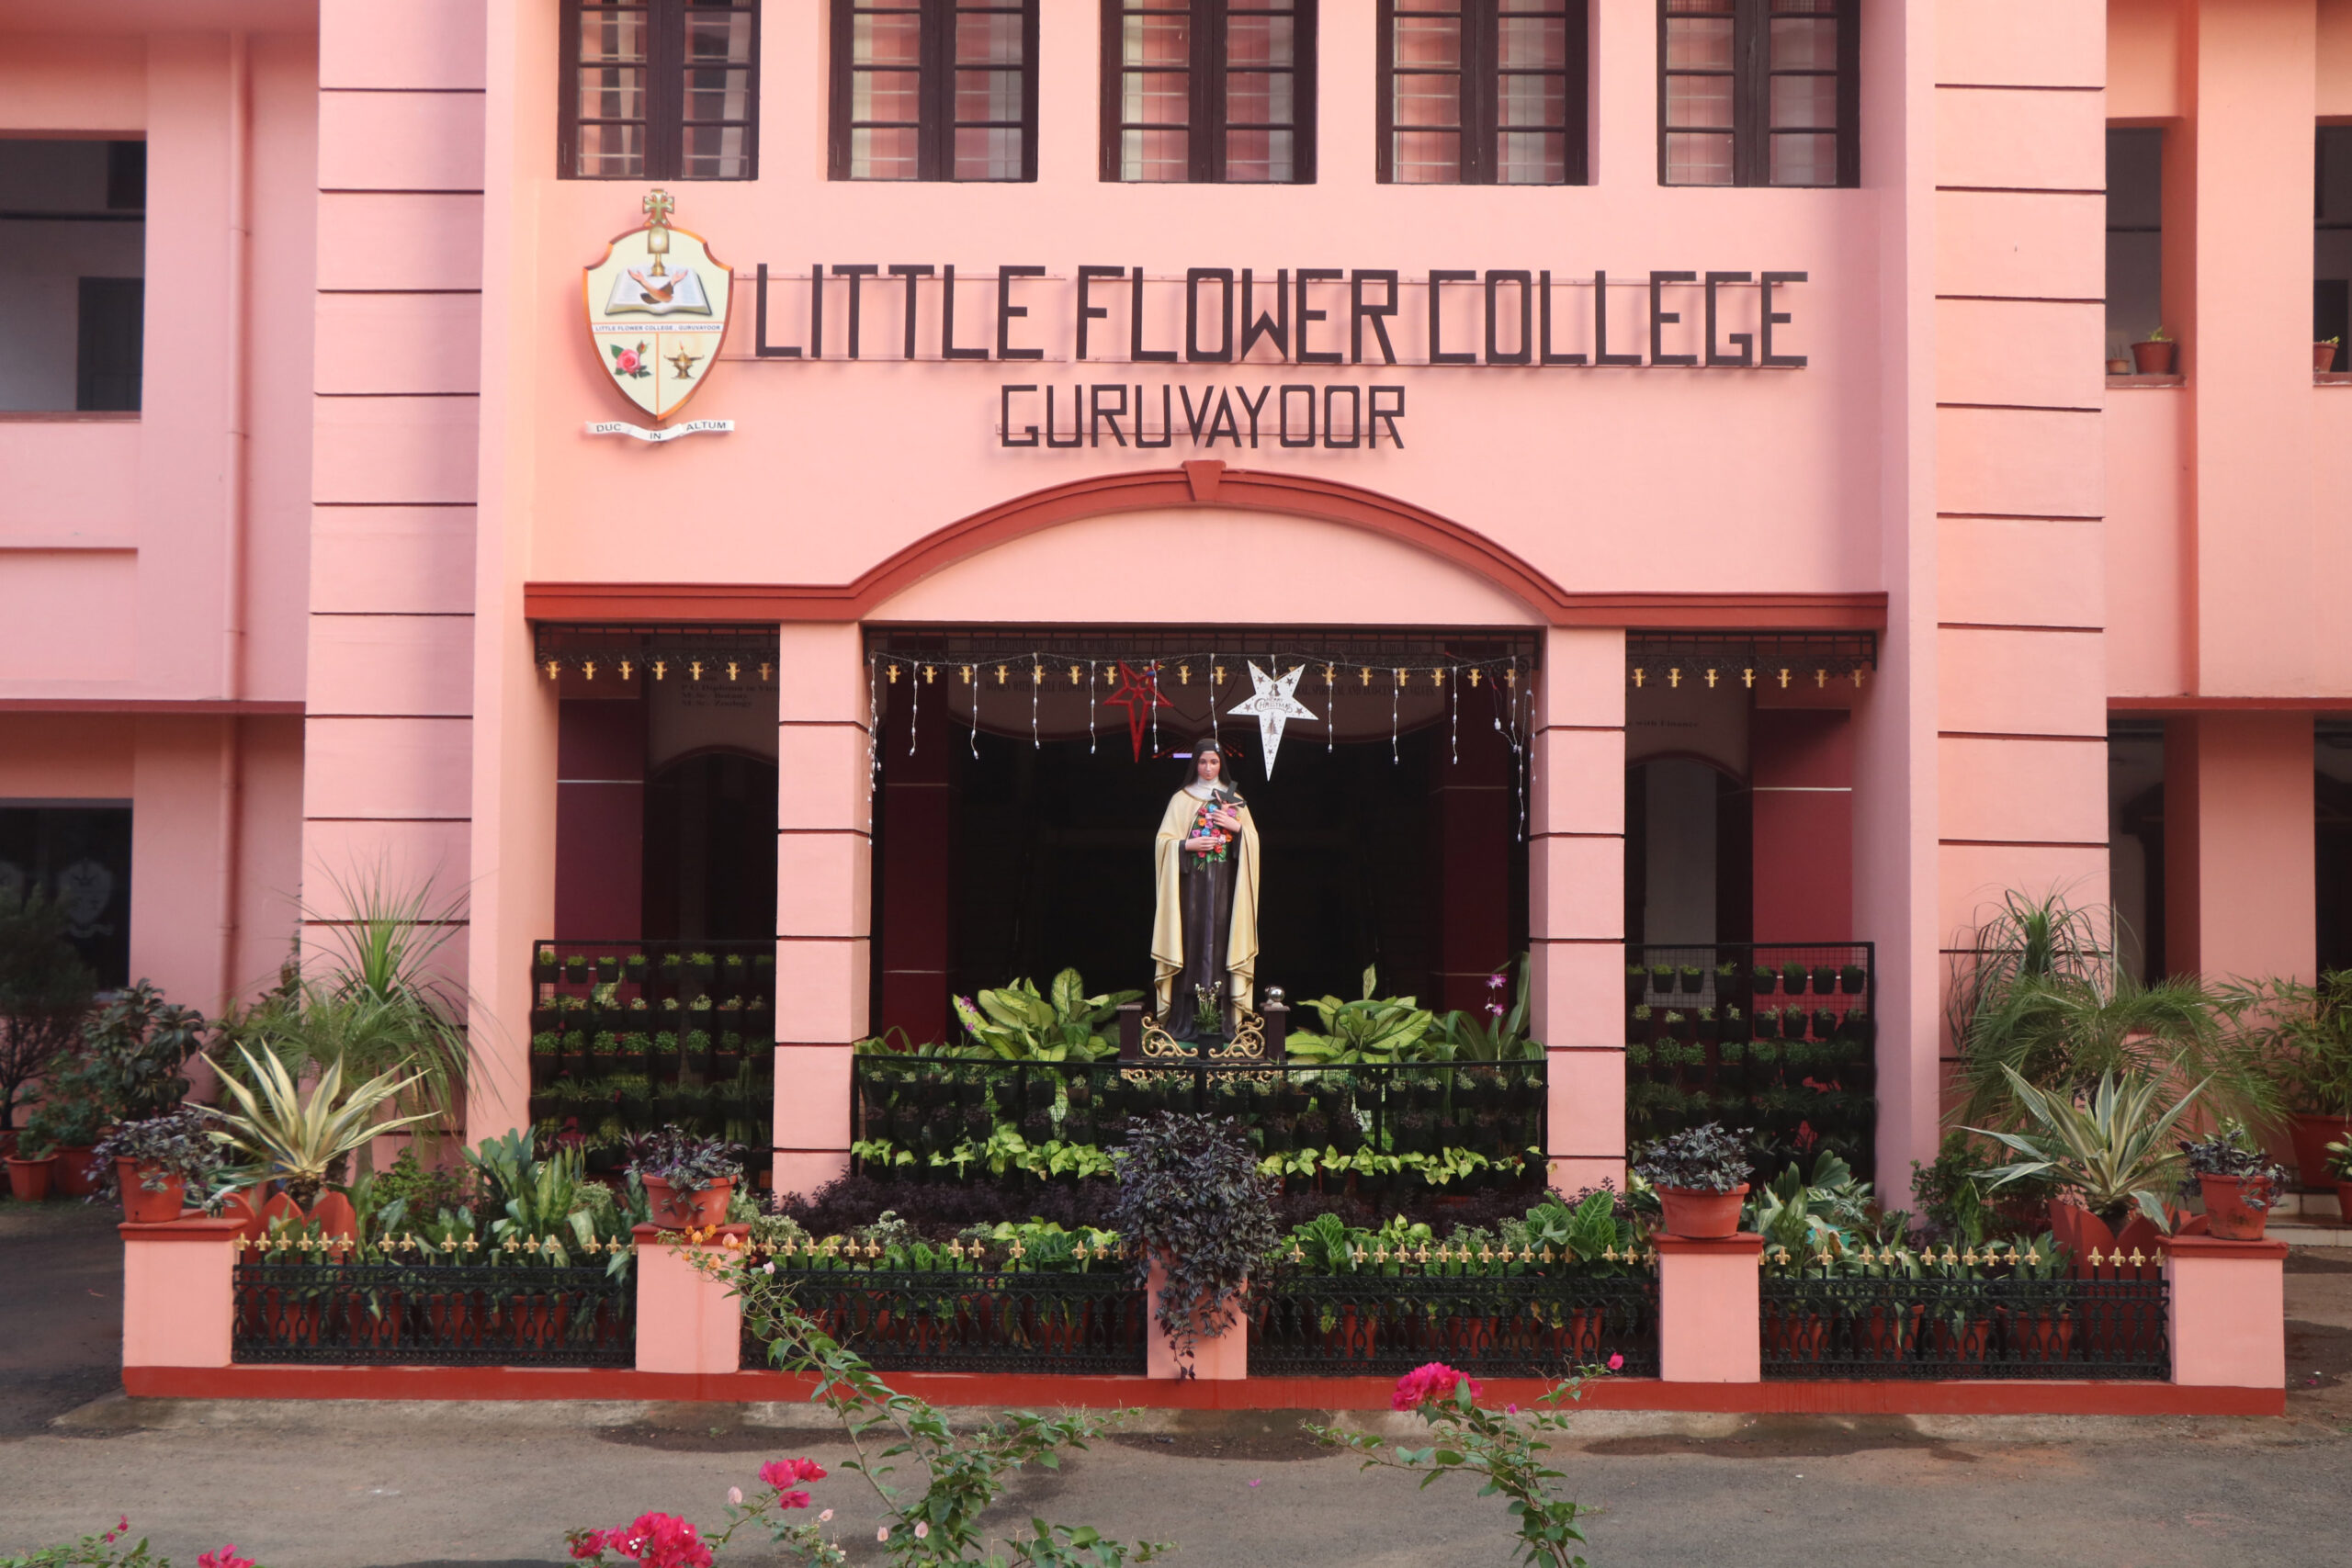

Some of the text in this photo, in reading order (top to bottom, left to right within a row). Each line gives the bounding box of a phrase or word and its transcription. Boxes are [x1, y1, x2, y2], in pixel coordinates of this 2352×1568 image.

[755, 263, 1808, 367] LITTLE FLOWER COLLEGE
[596, 423, 621, 432] DUC
[686, 421, 726, 431] ALTUM
[1001, 384, 1406, 449] GURUVAYOOR
